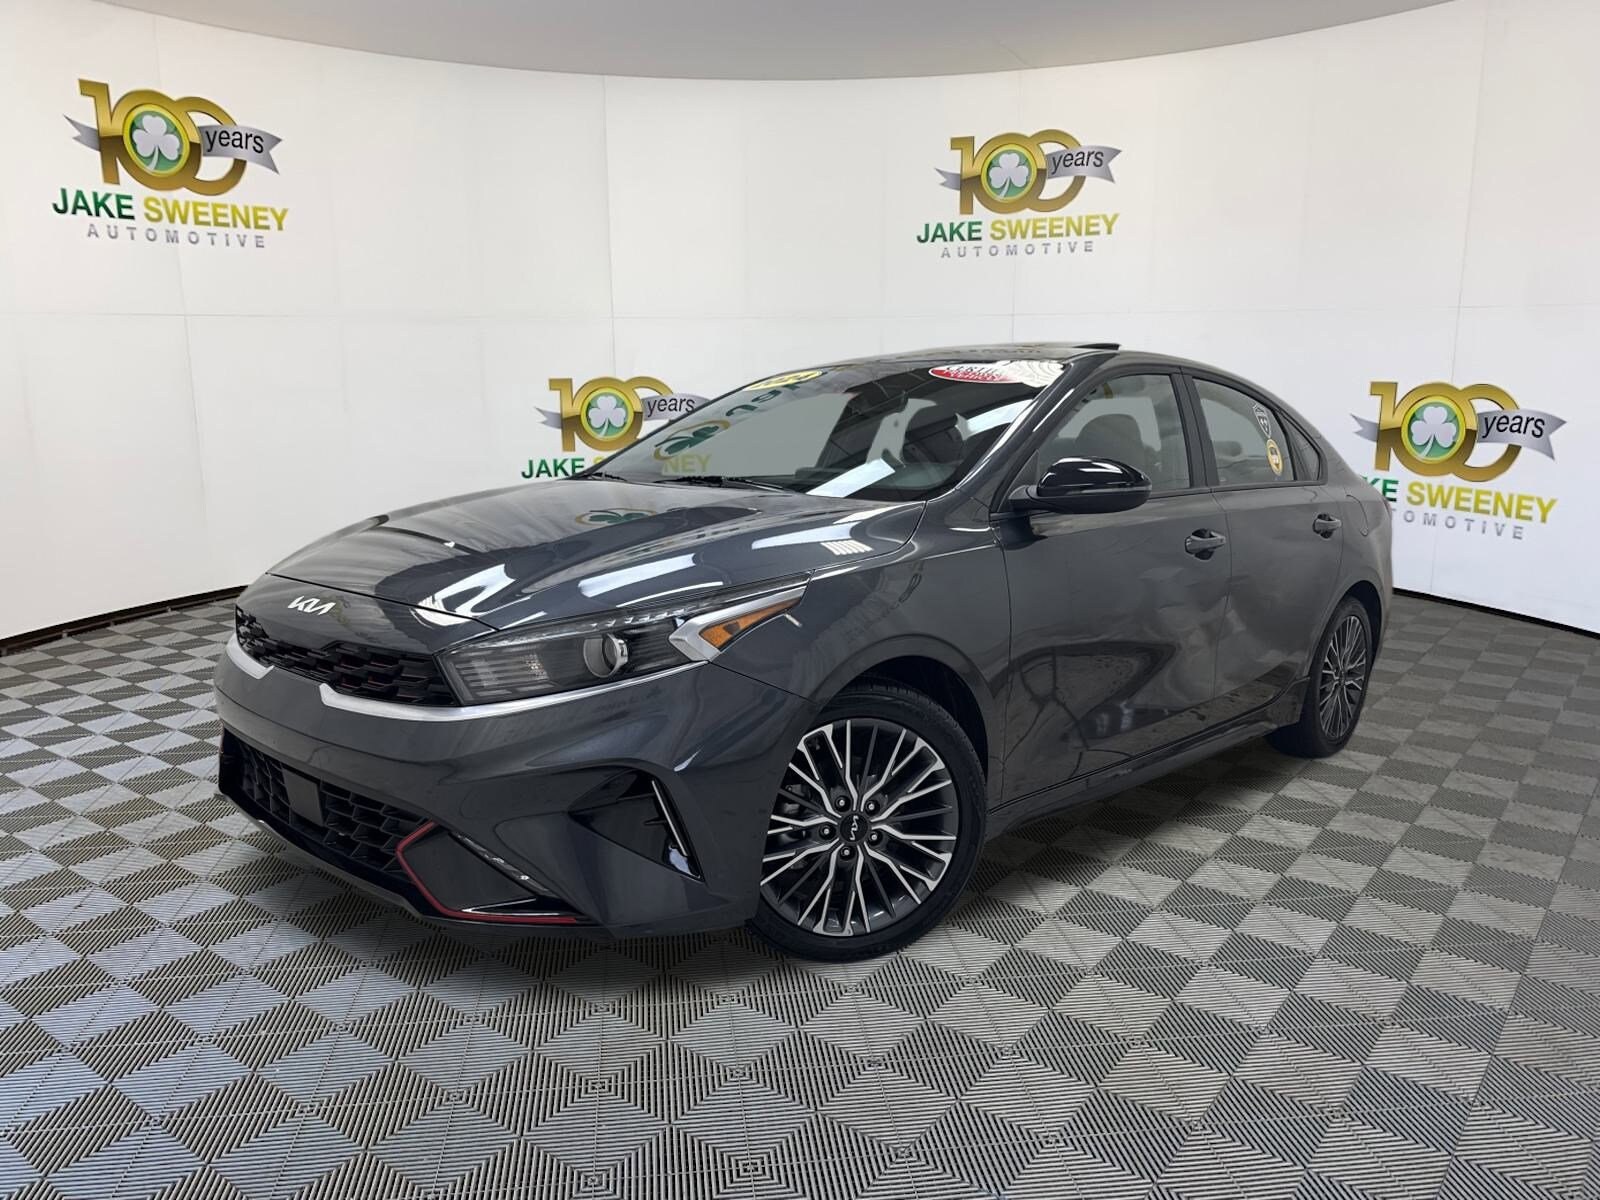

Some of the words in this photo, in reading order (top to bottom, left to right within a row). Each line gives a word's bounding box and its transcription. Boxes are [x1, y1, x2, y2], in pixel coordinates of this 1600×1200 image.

[78, 78, 247, 196] 100
[205, 129, 264, 154] years
[950, 128, 1087, 215] 100
[1051, 150, 1104, 175] years
[52, 187, 135, 220] JAKE
[143, 196, 289, 231] SWEENEY
[87, 223, 265, 248] AUTOMOTIVE
[916, 221, 983, 243] JAKE
[989, 213, 1120, 241] SWEENEY
[940, 241, 1093, 258] AUTOMOTIVE
[647, 397, 696, 417] years
[1369, 381, 1522, 482] 100
[1482, 414, 1546, 438] years
[521, 457, 585, 479] JAKE
[1406, 481, 1557, 524] SWEENEY
[1392, 508, 1524, 540] OMOTIVE
[287, 595, 336, 615] KIA
